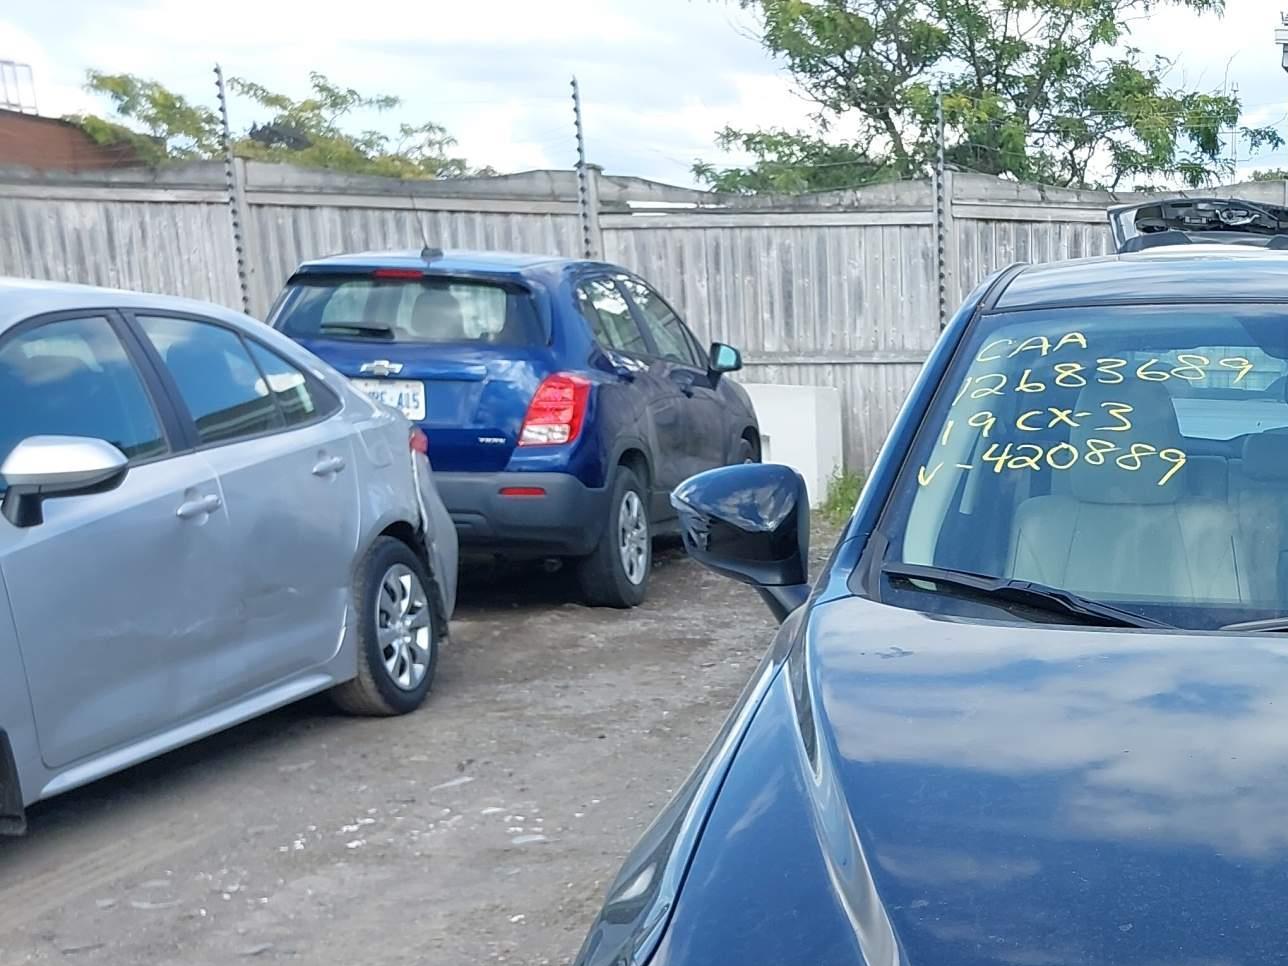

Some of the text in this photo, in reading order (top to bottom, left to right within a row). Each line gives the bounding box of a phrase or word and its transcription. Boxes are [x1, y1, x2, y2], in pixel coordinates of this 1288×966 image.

[975, 332, 1088, 362] CAA
[952, 354, 1254, 406] 12683689
[941, 410, 997, 445] 19
